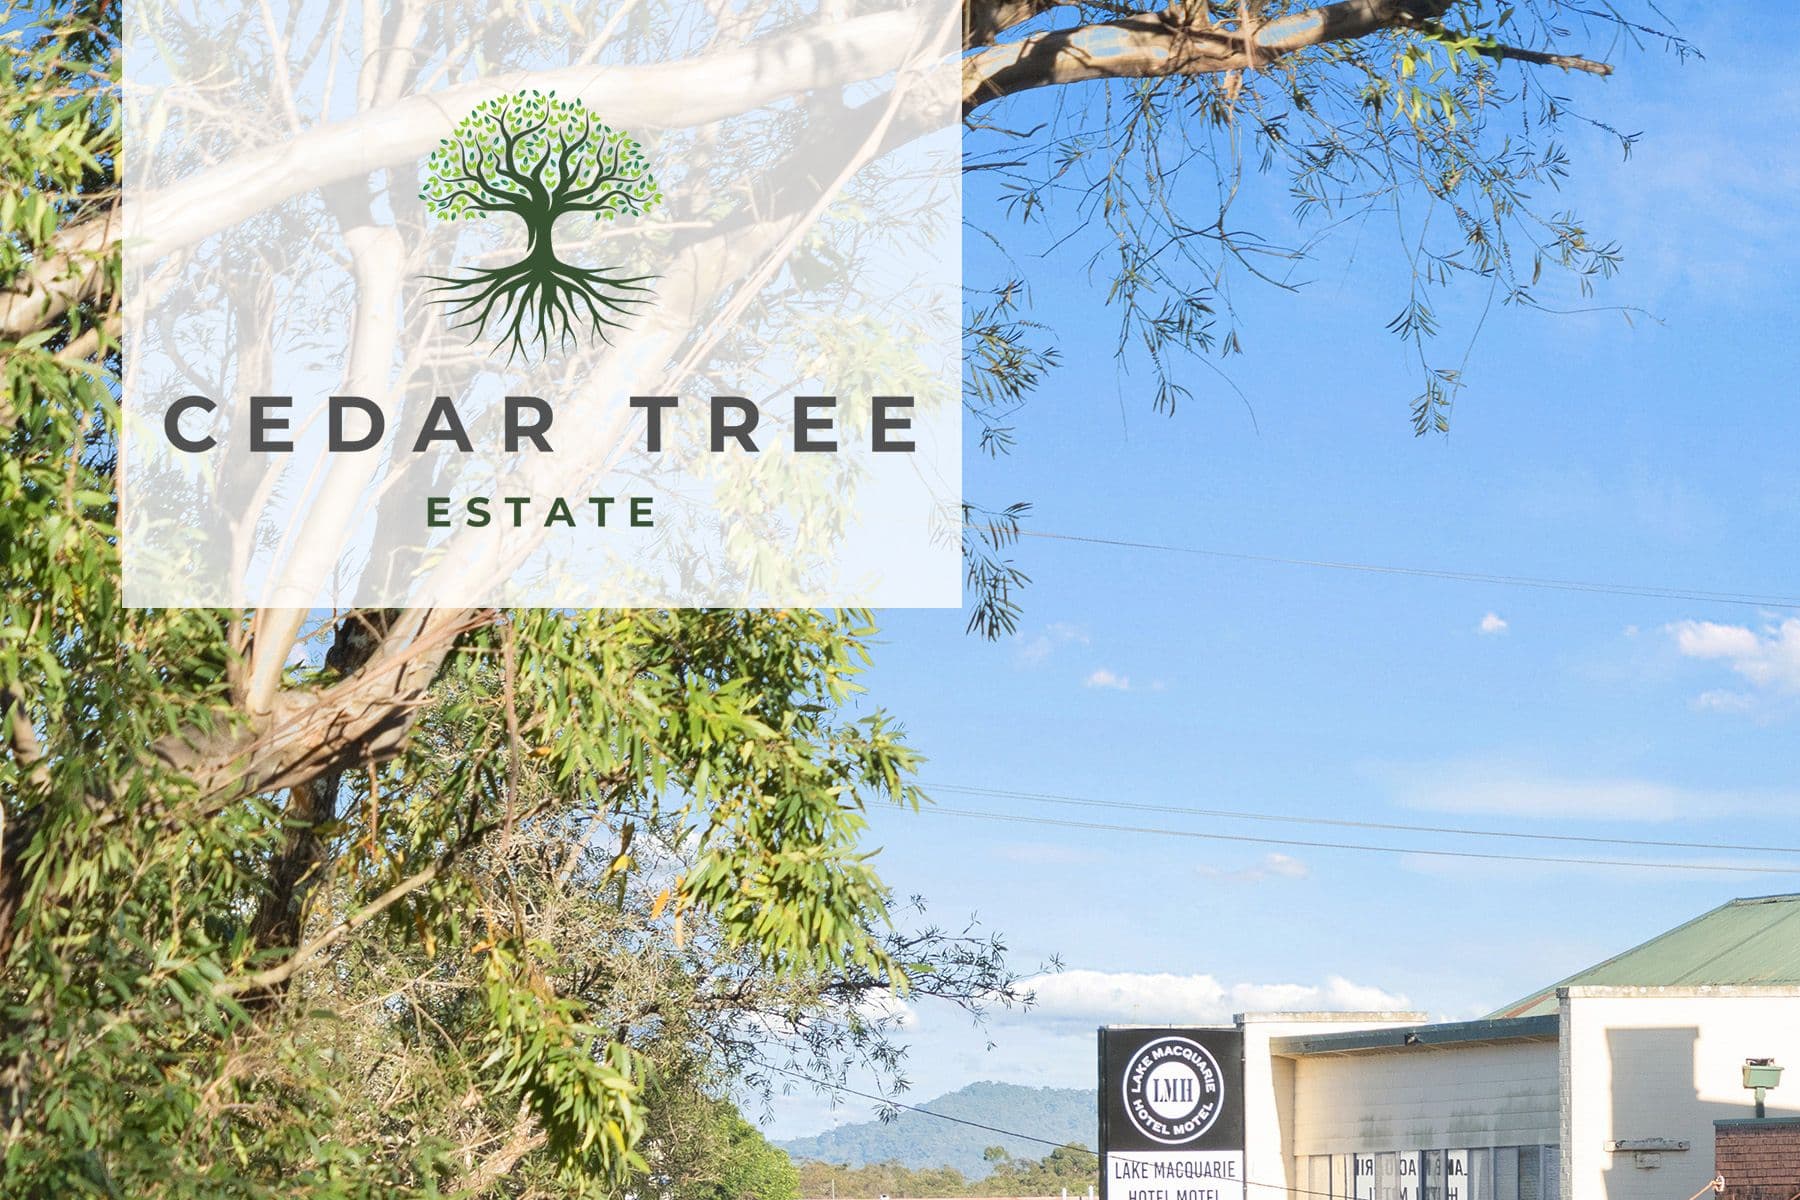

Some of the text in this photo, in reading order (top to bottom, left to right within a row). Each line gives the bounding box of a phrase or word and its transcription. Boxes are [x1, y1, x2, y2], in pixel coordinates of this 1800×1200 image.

[1131, 1045, 1216, 1093] LAKE MACQUARIE
[1153, 1078, 1193, 1103] LMH
[1133, 1098, 1214, 1136] HOTEL MOTEL
[1115, 1160, 1236, 1180] LAKE MACQUARIE
